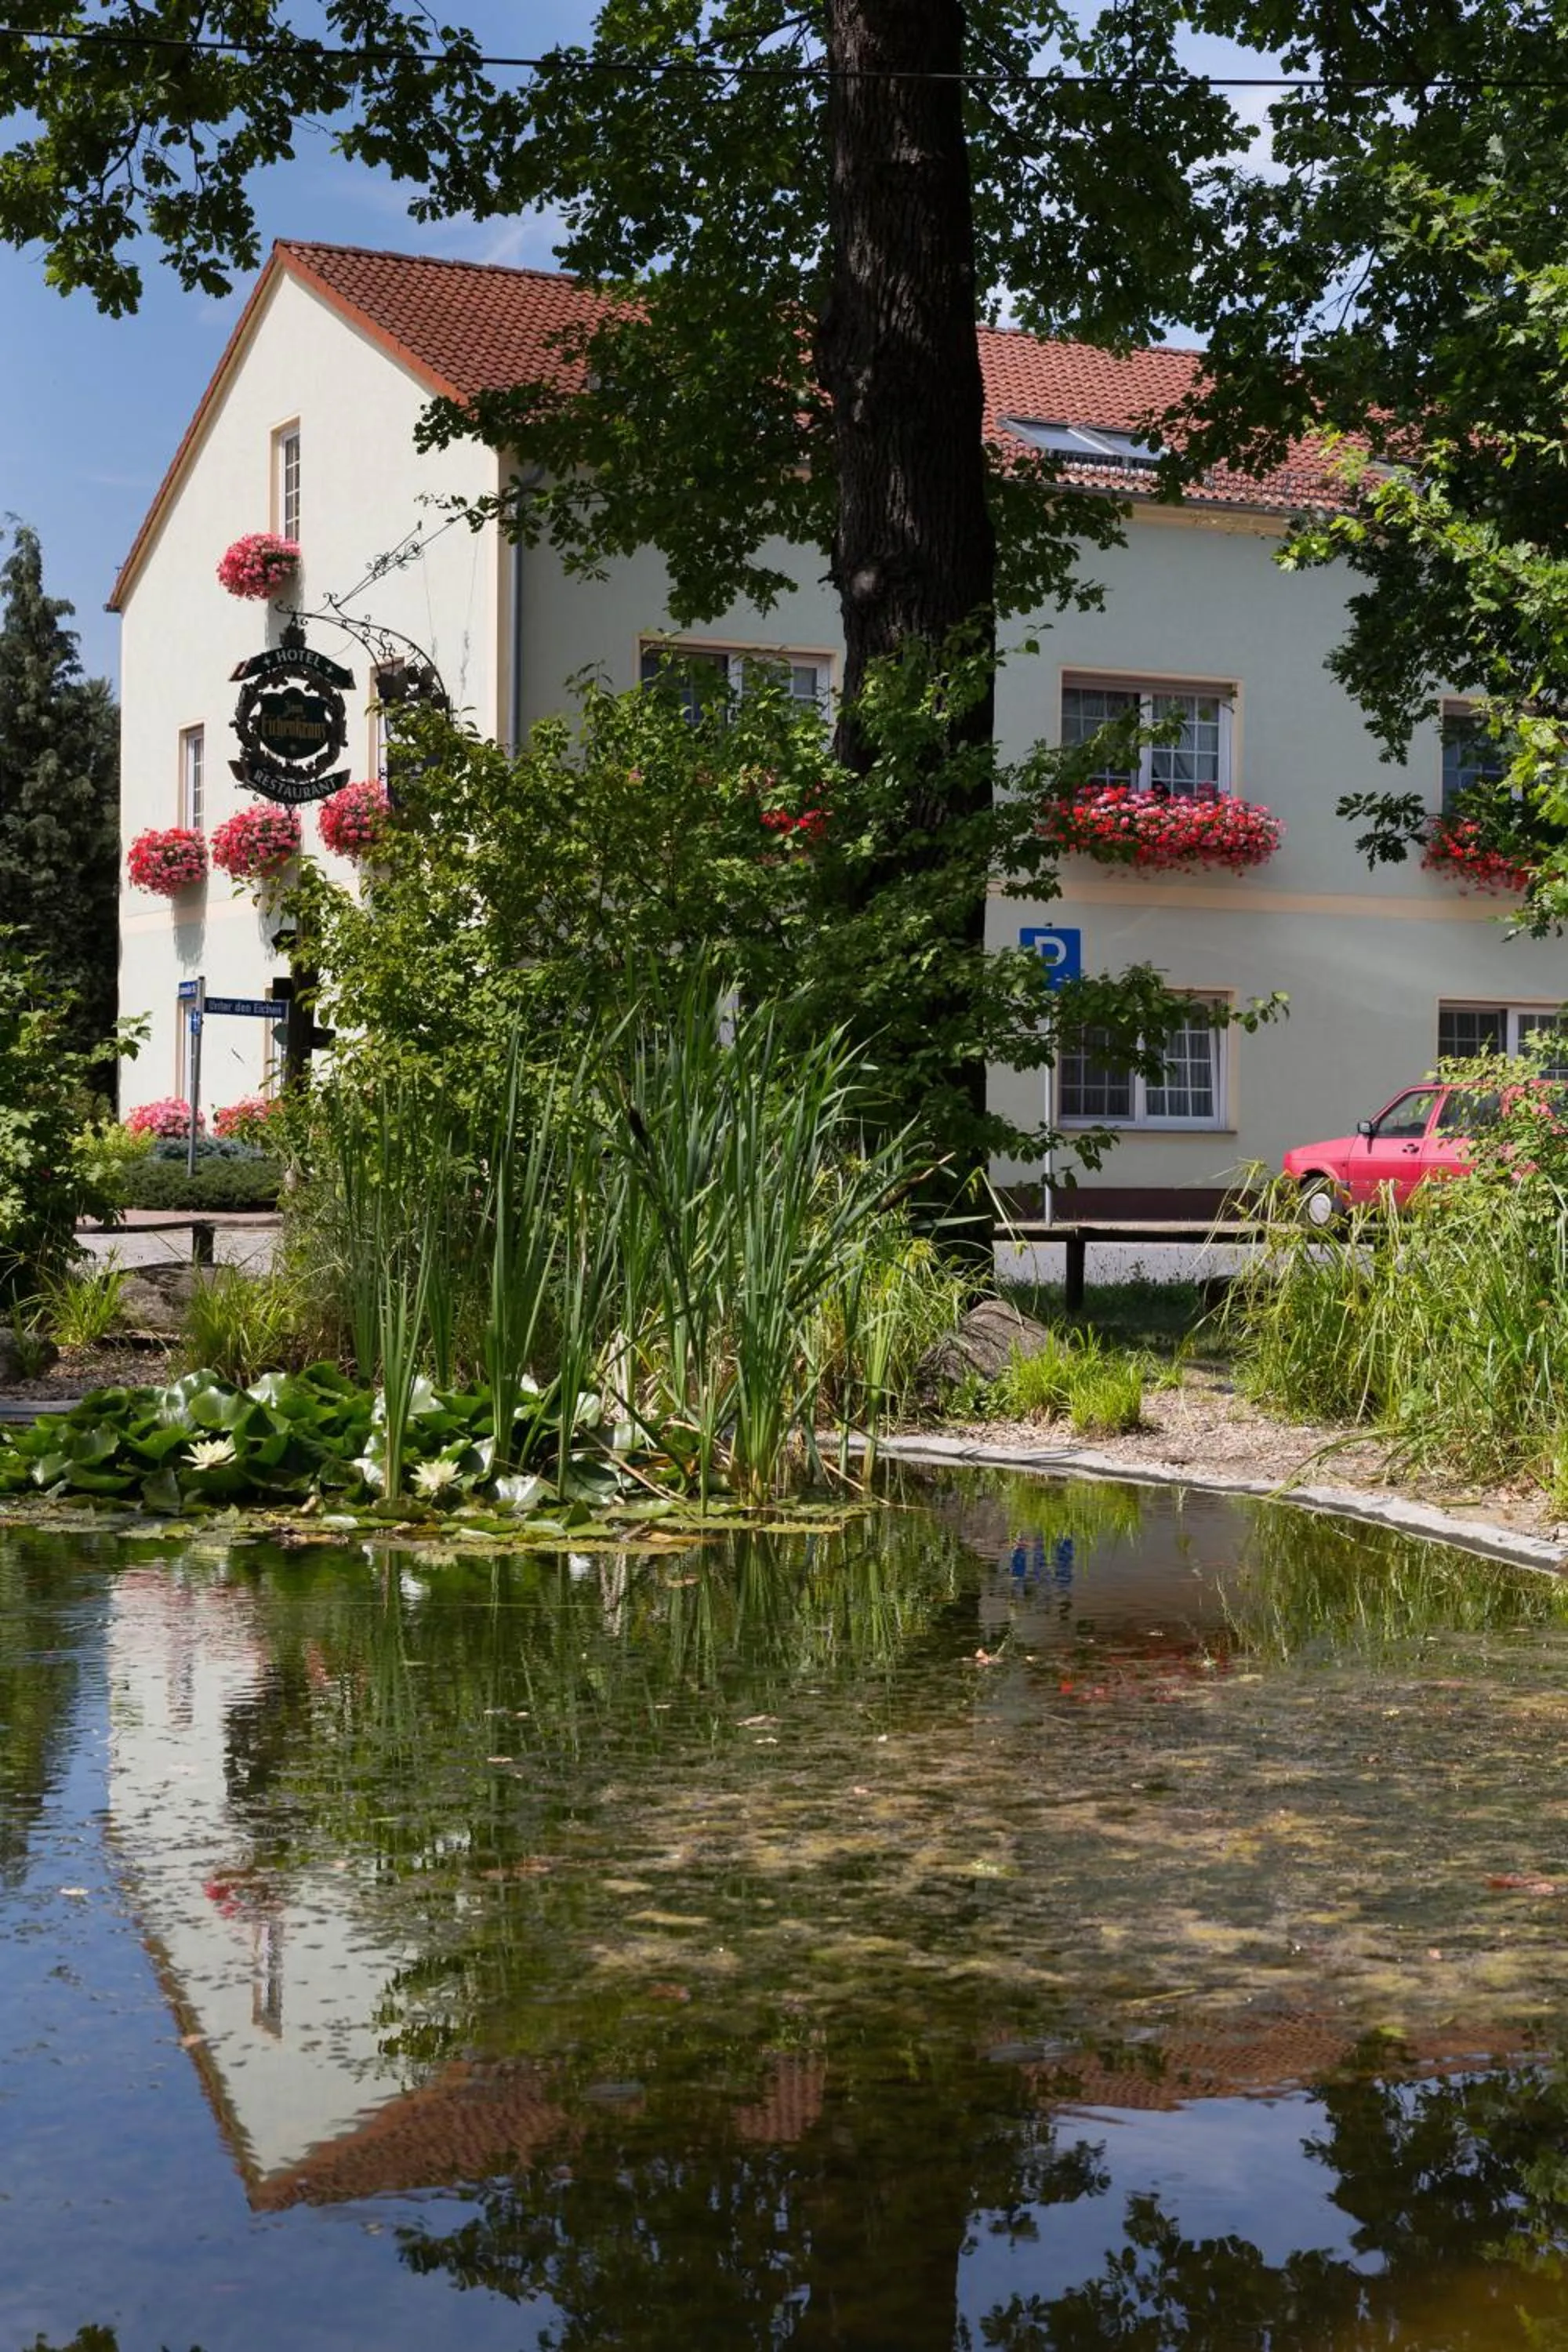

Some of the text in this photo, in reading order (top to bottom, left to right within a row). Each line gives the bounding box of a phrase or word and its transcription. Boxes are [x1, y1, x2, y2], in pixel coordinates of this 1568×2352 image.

[276, 649, 321, 666] HOTEL
[254, 768, 336, 799] RESTAURANT
[1034, 935, 1067, 967] P
[209, 1000, 282, 1014] Unter den Eichen
